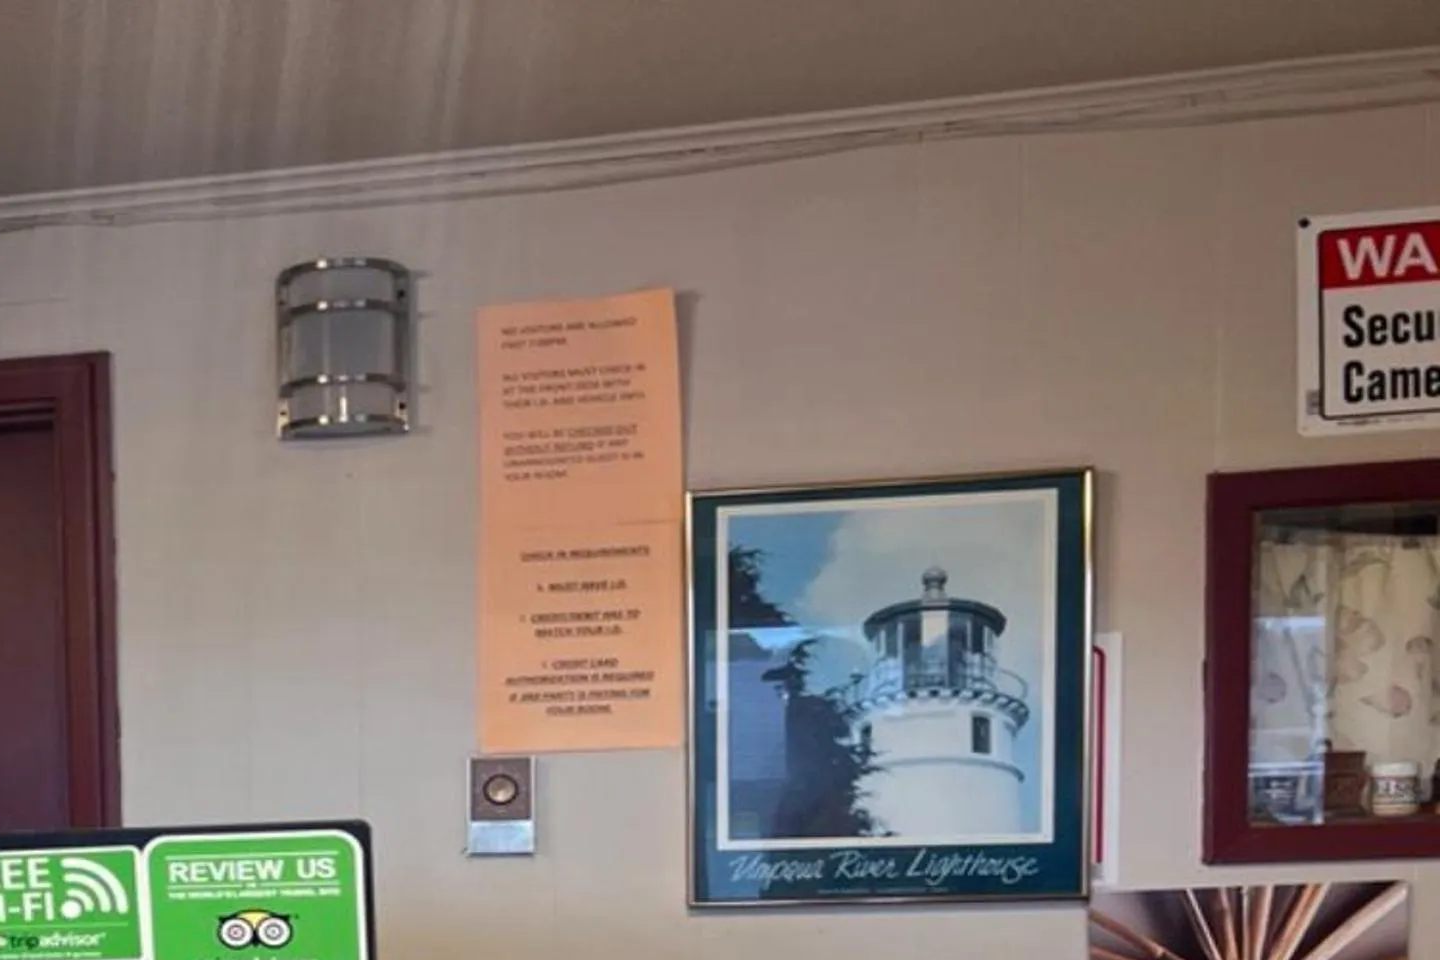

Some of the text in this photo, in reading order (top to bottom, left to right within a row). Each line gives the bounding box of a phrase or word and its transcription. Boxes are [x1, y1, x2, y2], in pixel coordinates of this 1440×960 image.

[1343, 305, 1440, 348] Secu
[520, 368, 565, 381] VISITORS
[567, 365, 597, 378] MUST
[548, 581, 578, 593] MUST
[602, 670, 655, 683] REQUIRED
[168, 857, 337, 883] REVIEW US
[830, 848, 900, 880] River
[904, 848, 1041, 885] Lighthouse
[10, 931, 101, 950] tripadvisor
